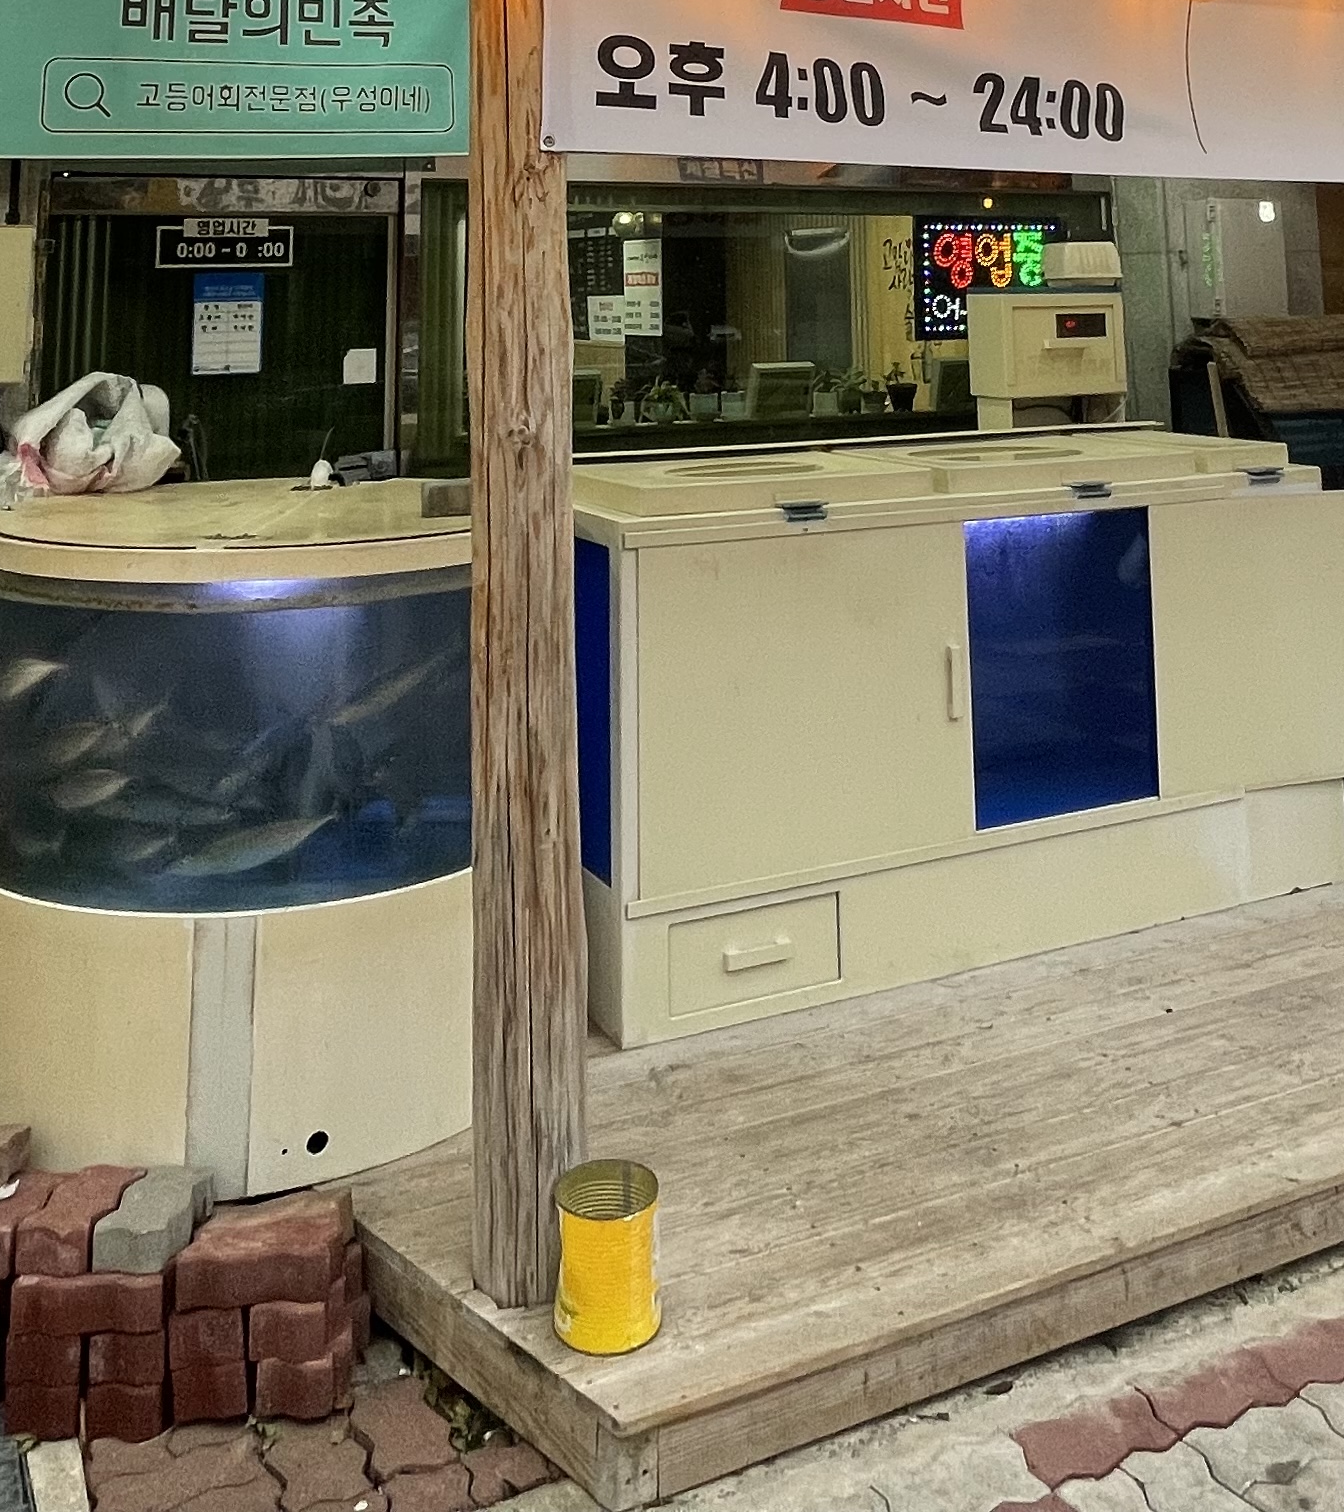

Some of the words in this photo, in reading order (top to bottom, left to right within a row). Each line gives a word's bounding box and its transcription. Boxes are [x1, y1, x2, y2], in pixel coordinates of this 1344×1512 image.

[594, 34, 726, 118] 오후
[755, 50, 886, 128] 4:00
[971, 72, 1125, 143] 24:00
[197, 219, 258, 236] 영업시간
[933, 232, 1044, 288] 영업중
